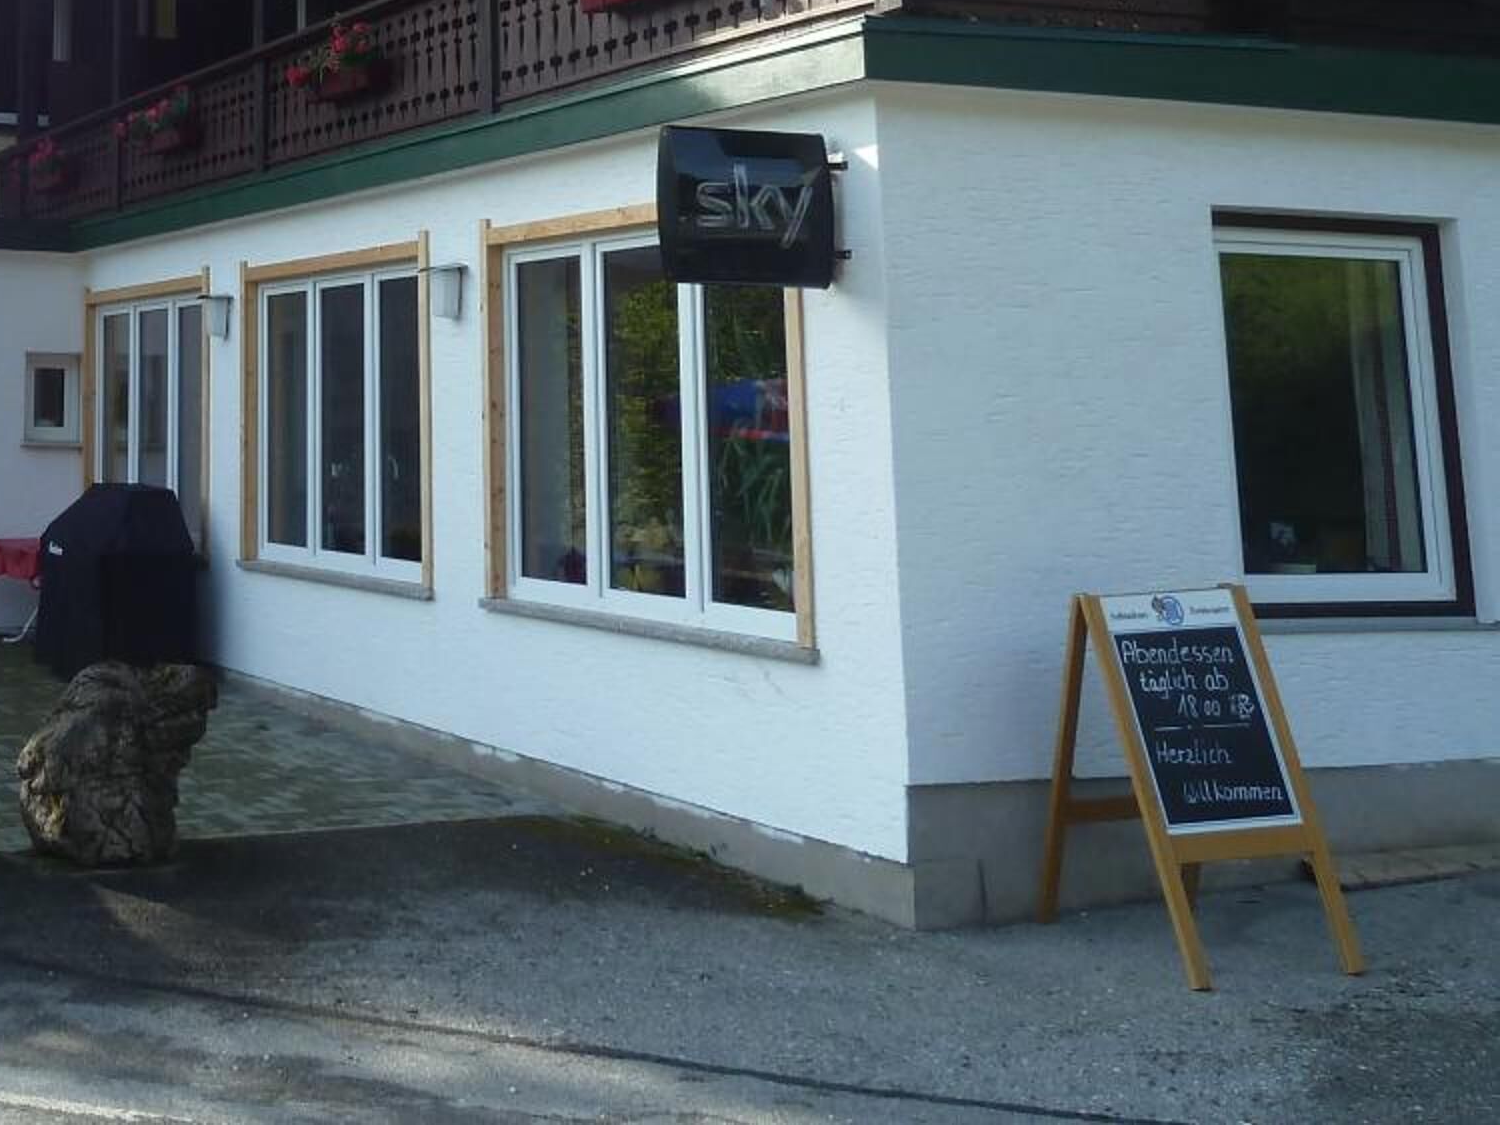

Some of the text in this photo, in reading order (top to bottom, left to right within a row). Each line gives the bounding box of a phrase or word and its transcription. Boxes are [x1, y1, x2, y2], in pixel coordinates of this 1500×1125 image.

[1120, 637, 1234, 664] Abendessen
[1139, 666, 1230, 699] täglich ab
[1155, 740, 1233, 765] Herzlich
[1183, 780, 1285, 804] Willkommen
